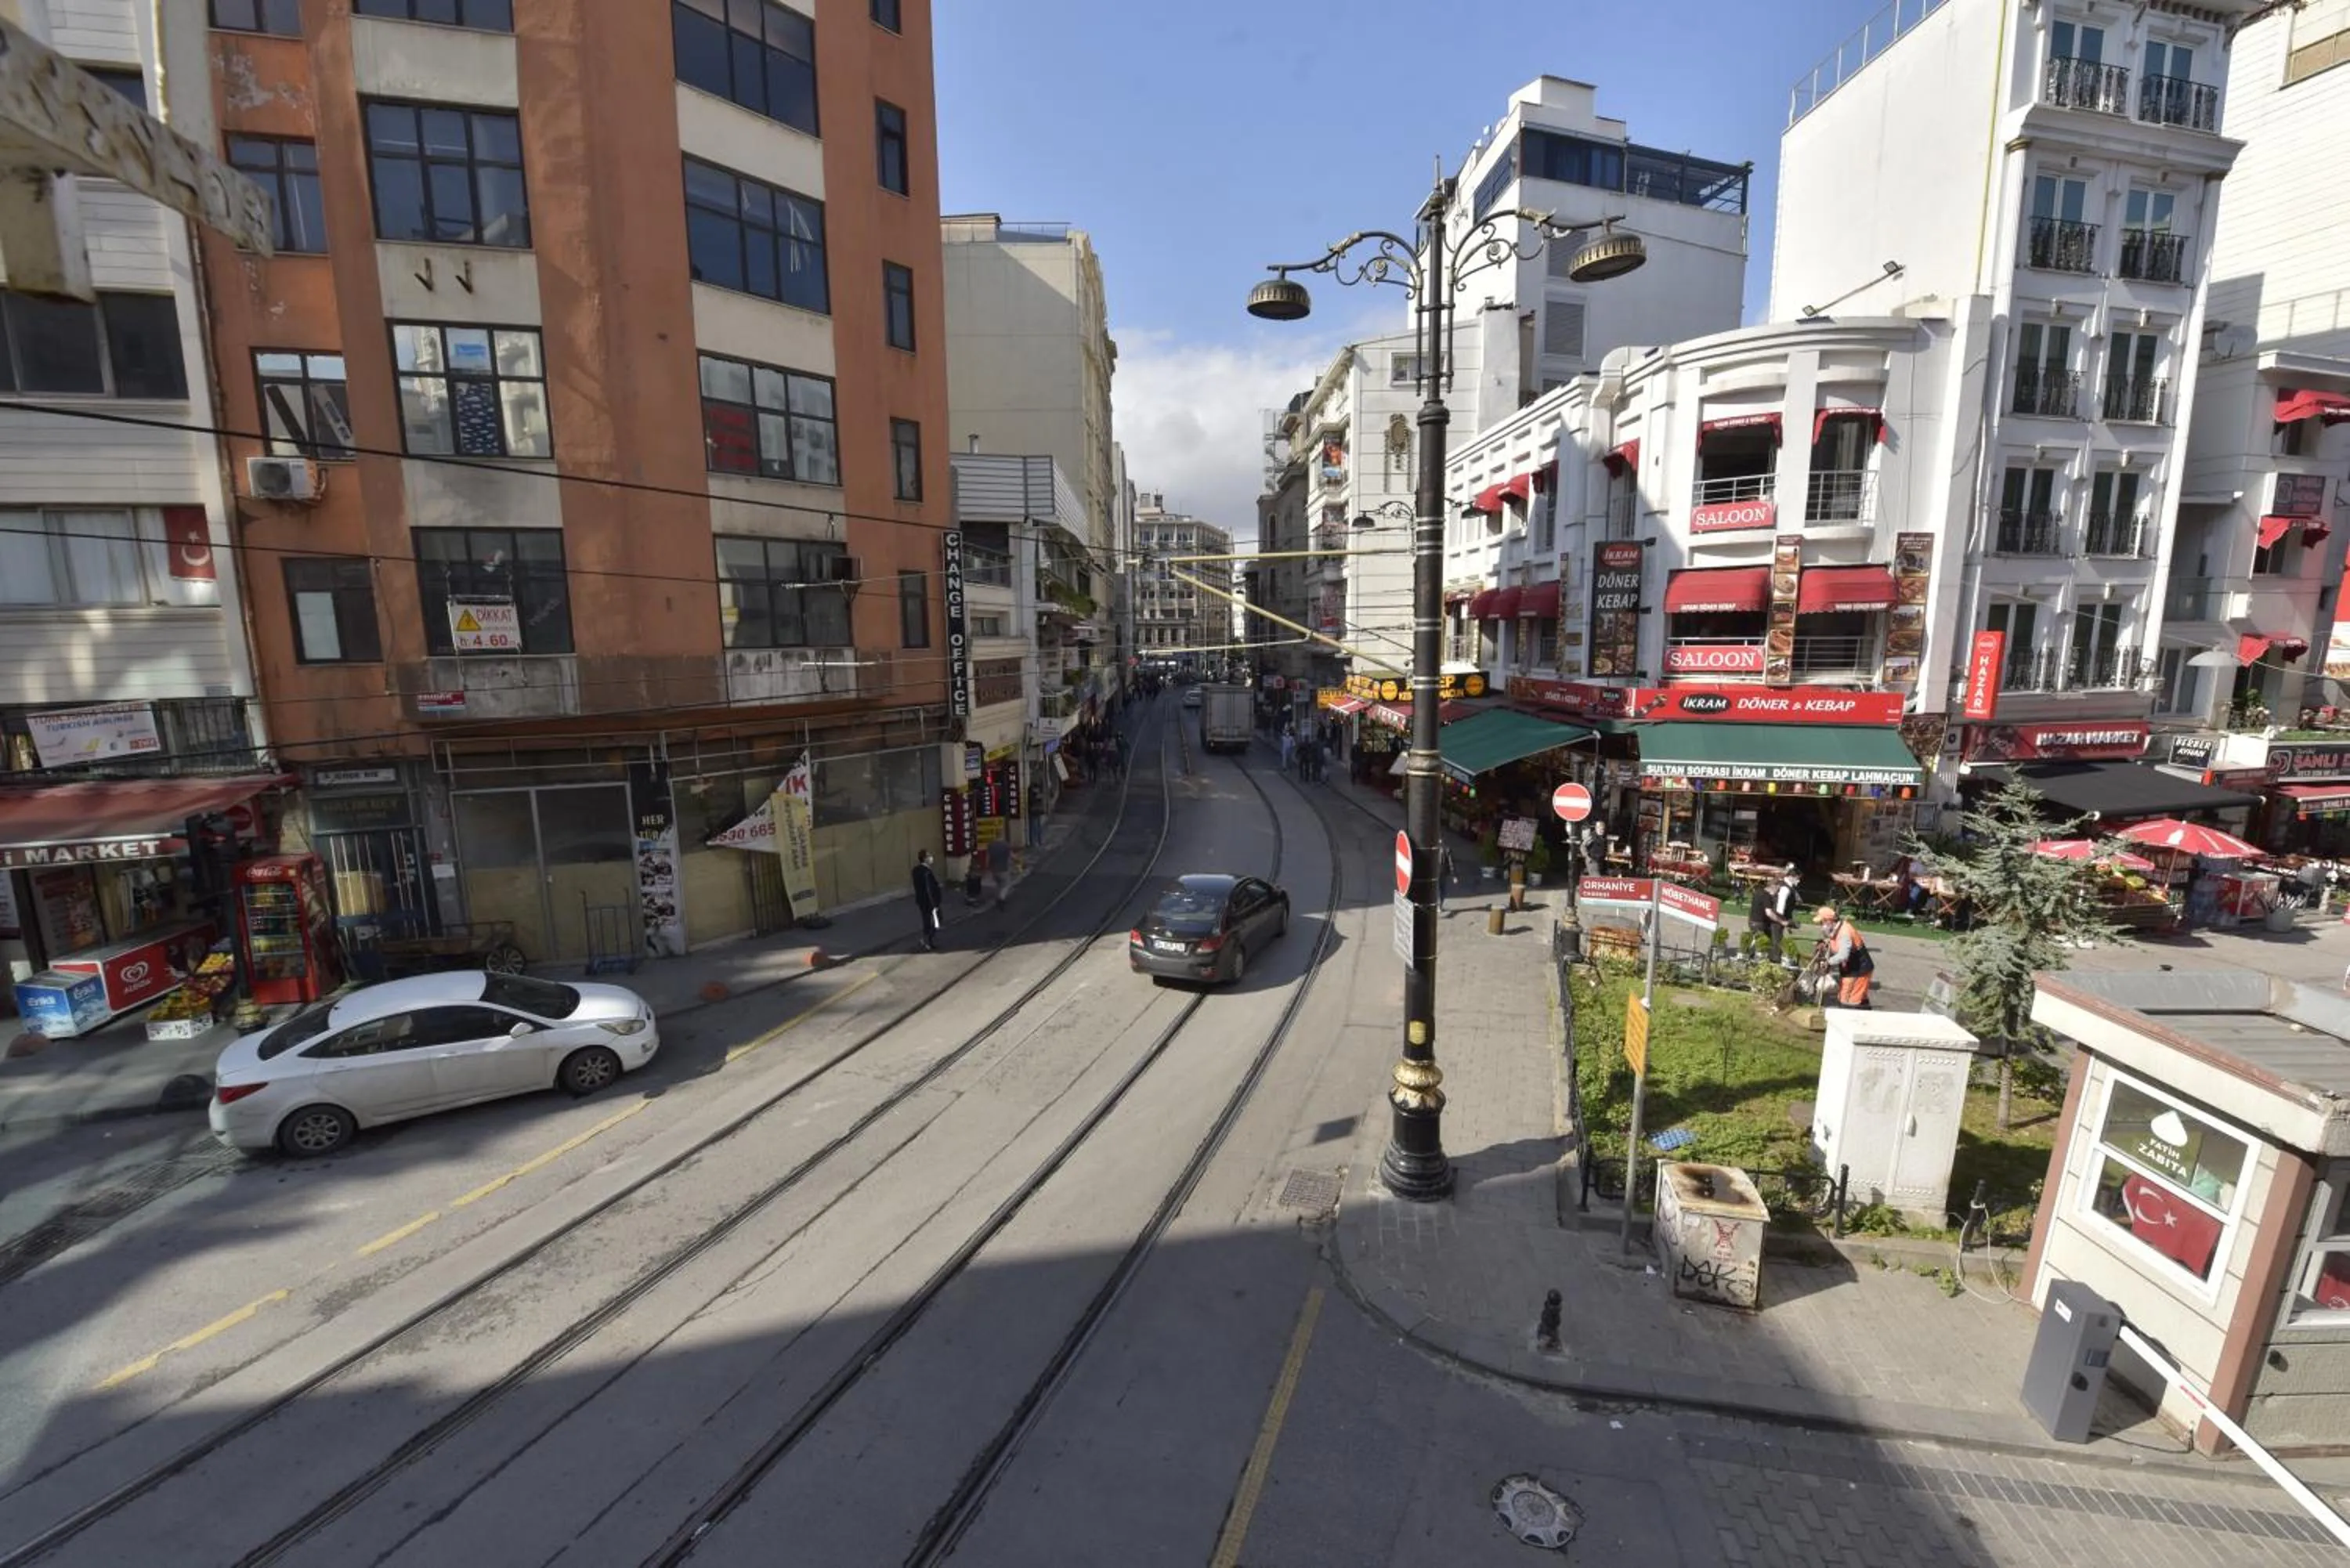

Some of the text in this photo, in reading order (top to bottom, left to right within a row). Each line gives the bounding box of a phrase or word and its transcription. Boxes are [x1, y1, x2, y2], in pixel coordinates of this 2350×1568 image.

[1695, 508, 1766, 526] SALOON
[1598, 571, 1640, 589] DÖNER
[1596, 593, 1639, 609] KEBAP
[475, 608, 512, 622] DİKKAT
[945, 533, 966, 716] CHANGE OFFICE
[1669, 652, 1756, 667] SALOON
[1973, 656, 1989, 708] HAZAR
[1683, 696, 1727, 710] İKRAM
[1737, 696, 1790, 710] DÖNER
[1804, 699, 1856, 713] KEBAP
[46, 714, 134, 732] TURKISH AIRLINES
[2036, 730, 2142, 746] HAZAR MARKET
[2175, 736, 2212, 750] BERBER
[1647, 764, 1914, 784] SULTAN SOFRASI İKRAM DÖNER KEBAP LAHMACUN
[641, 814, 665, 825] HER
[944, 793, 953, 852] CHANGE
[24, 841, 161, 865] MARKET
[1583, 880, 1636, 893] ORHANİYE
[2149, 1138, 2180, 1160] FATİH
[2138, 1142, 2188, 1179] ZABITA
